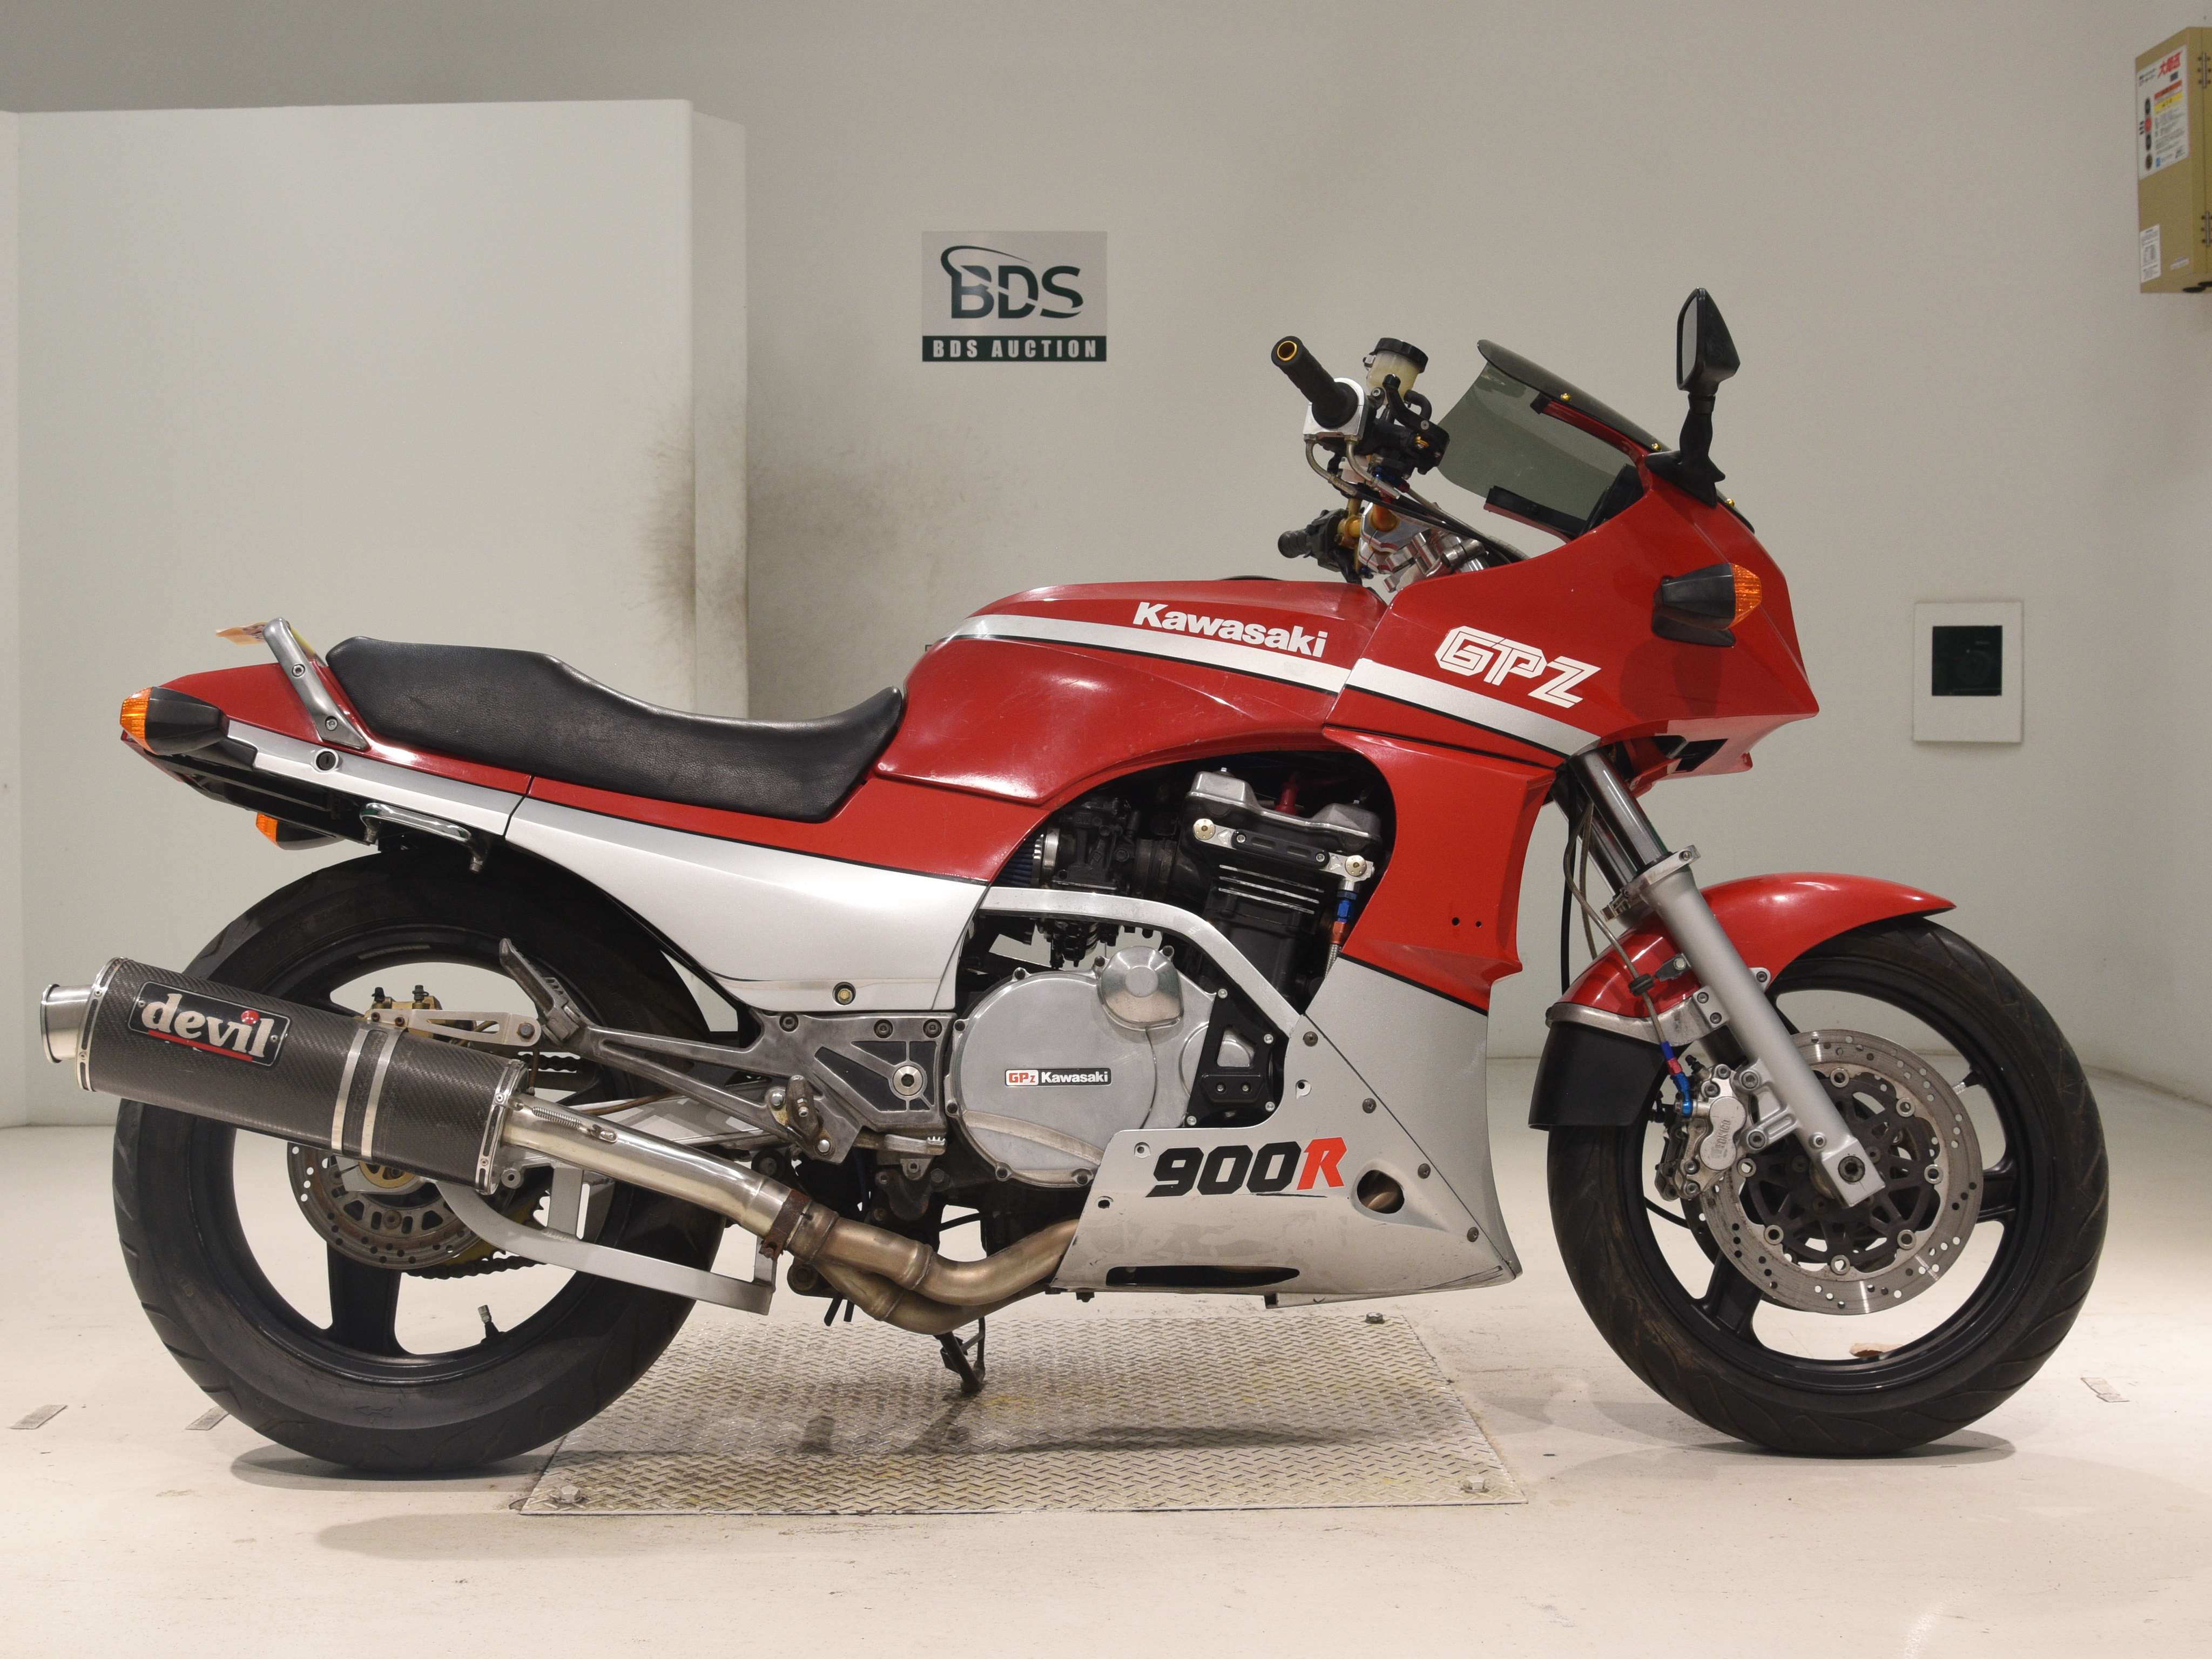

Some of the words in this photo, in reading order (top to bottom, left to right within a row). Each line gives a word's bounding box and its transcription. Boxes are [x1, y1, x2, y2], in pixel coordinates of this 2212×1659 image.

[941, 246, 1083, 319] BDS
[933, 340, 977, 358] BDS
[992, 340, 1096, 358] AUCTION
[1132, 602, 1328, 658] Kawasaki
[141, 993, 274, 1057] devil
[1041, 1071, 1108, 1083] Kawasaki
[1145, 1137, 1347, 1198] 900R
